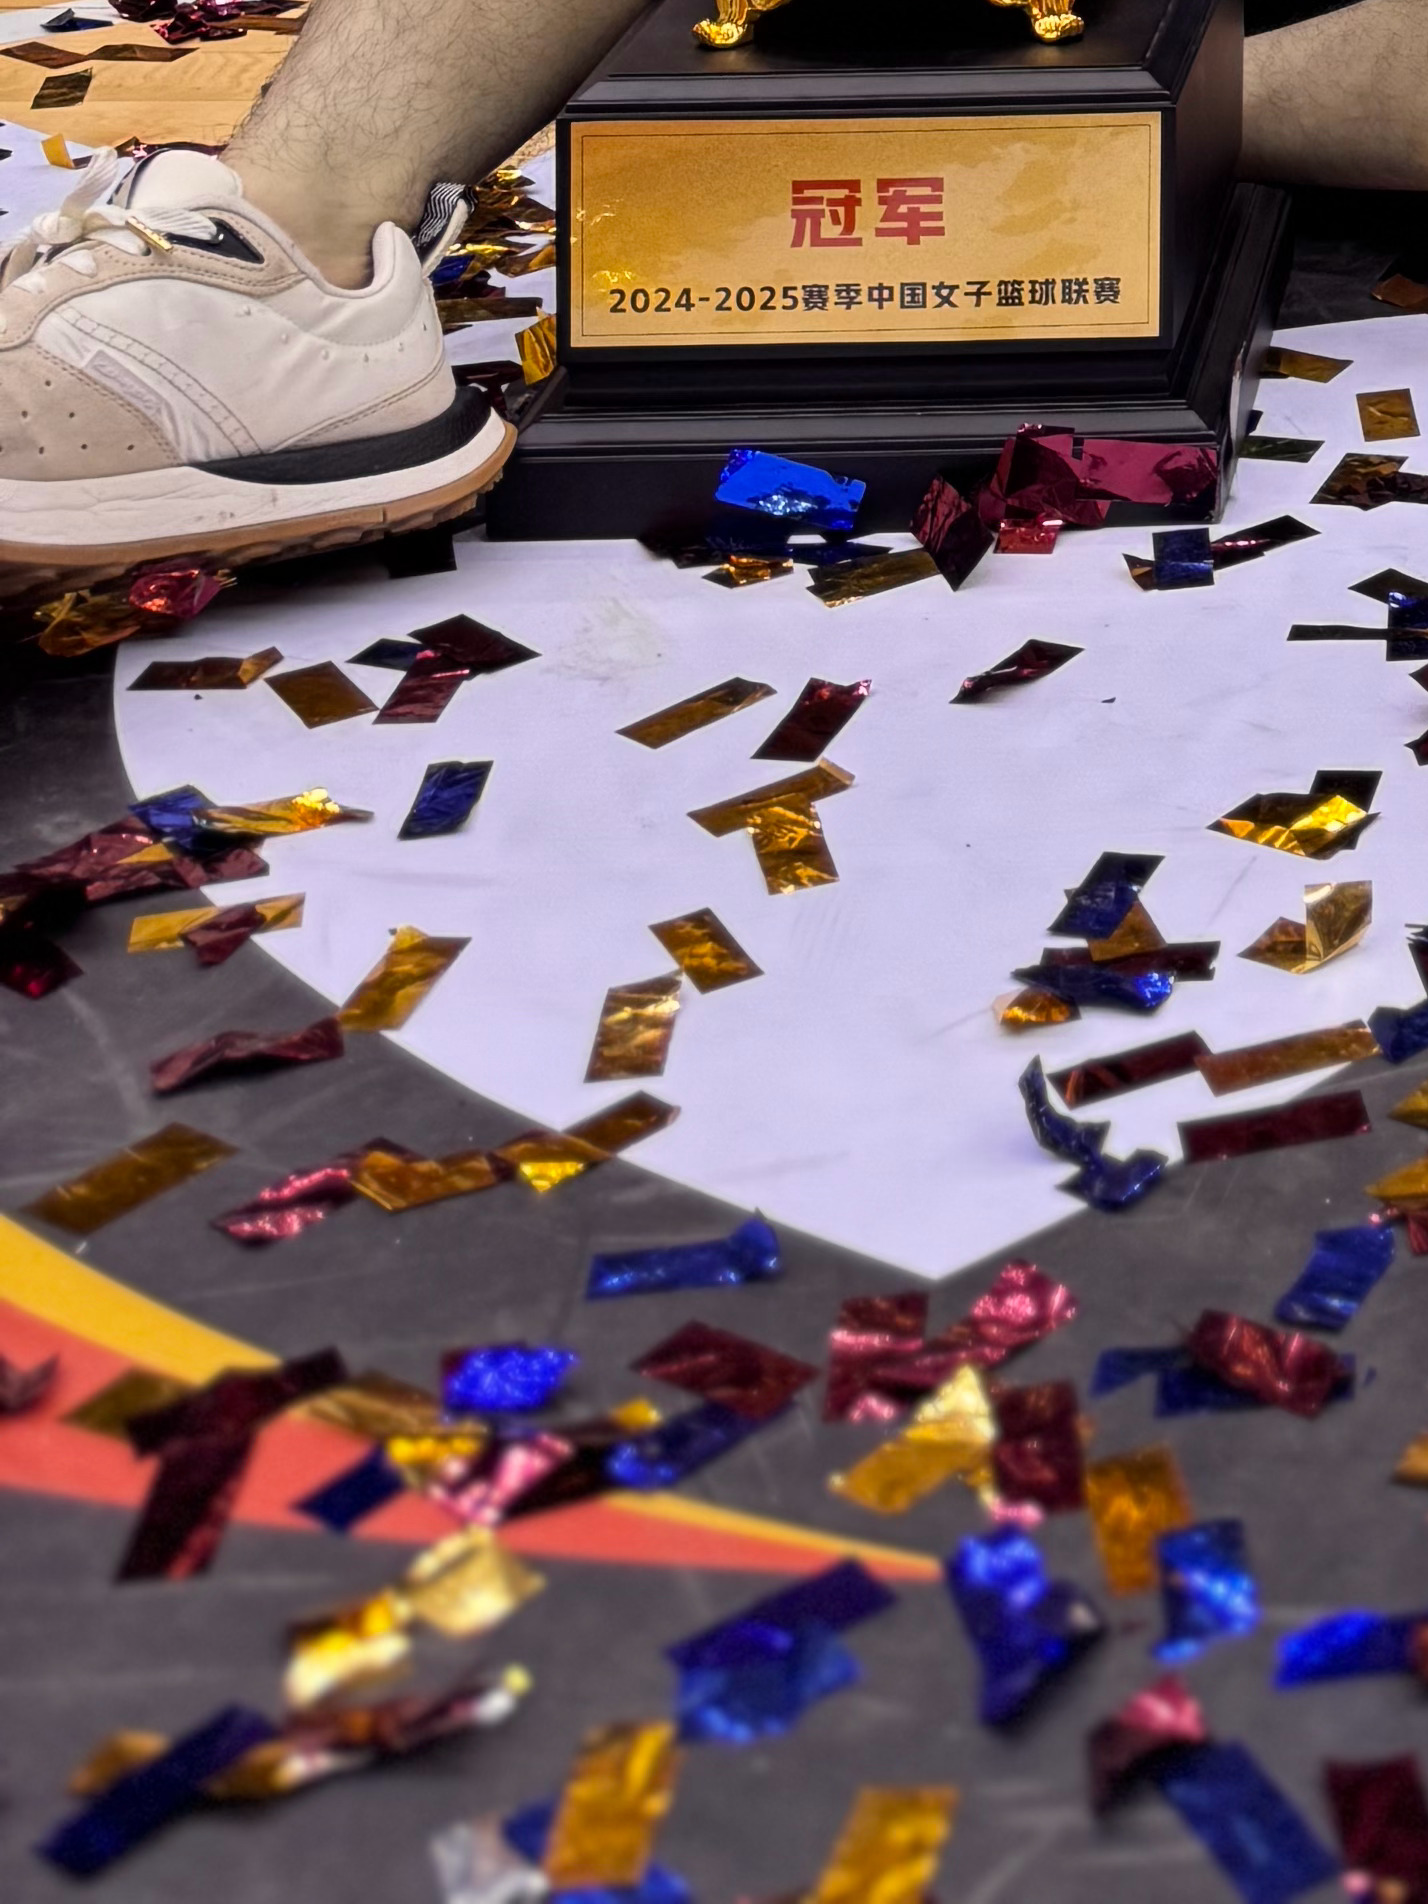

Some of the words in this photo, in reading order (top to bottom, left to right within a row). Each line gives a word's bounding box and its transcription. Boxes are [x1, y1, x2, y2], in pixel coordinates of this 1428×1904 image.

[789, 176, 946, 249] 冠军
[608, 276, 1122, 314] 2024-2025赛季中国女子篮球联赛
